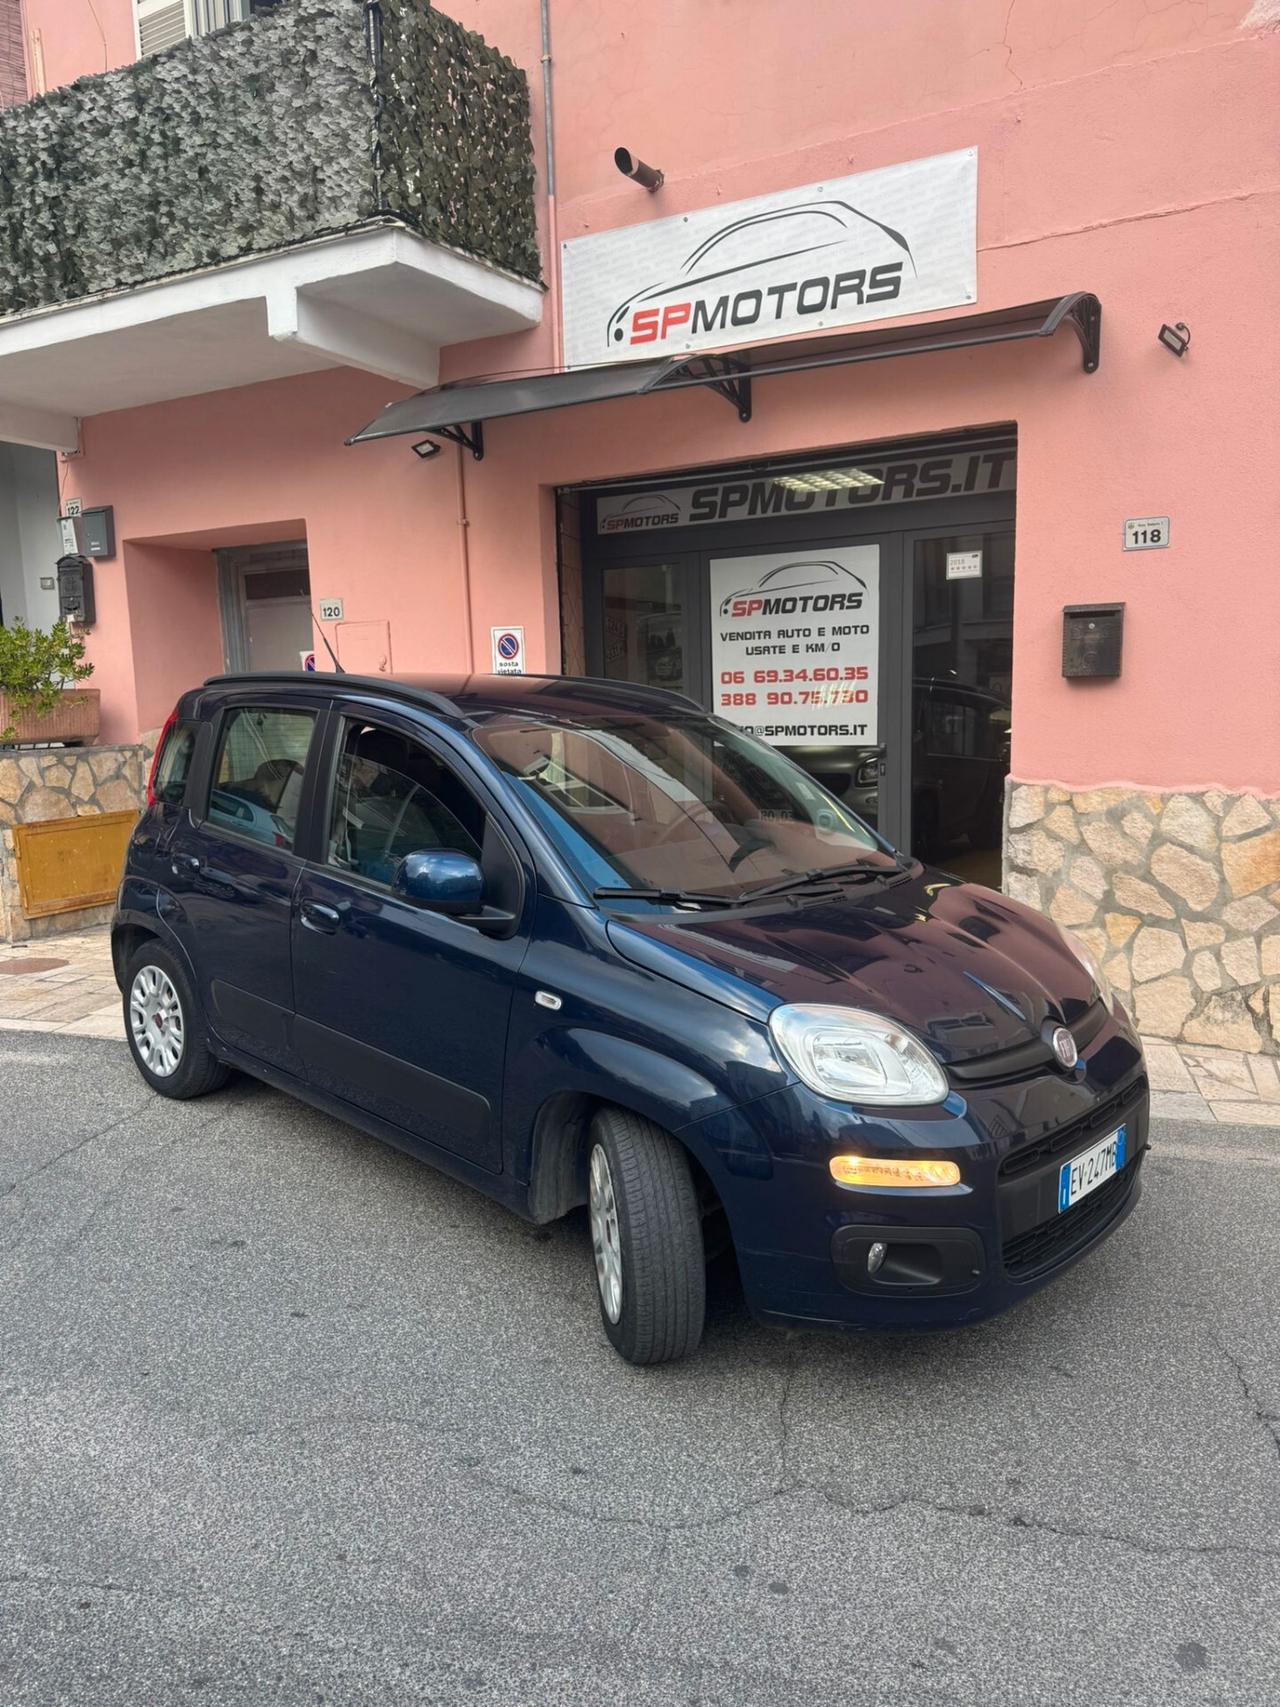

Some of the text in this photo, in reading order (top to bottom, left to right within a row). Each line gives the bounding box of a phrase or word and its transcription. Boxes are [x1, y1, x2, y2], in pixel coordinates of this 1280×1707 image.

[629, 261, 903, 345] SPMOTORS
[68, 505, 79, 515] 122
[607, 513, 680, 530] SPMOTORS
[1132, 529, 1161, 544] 118
[323, 607, 340, 617] 120
[731, 592, 864, 617] SPMOTORS
[720, 624, 870, 641] VENDITA AUTO E MOTO
[746, 644, 786, 656] USATE
[792, 644, 800, 653] E
[721, 666, 868, 684] 06 69.34.60.35
[721, 690, 869, 706] 388 90.75.730
